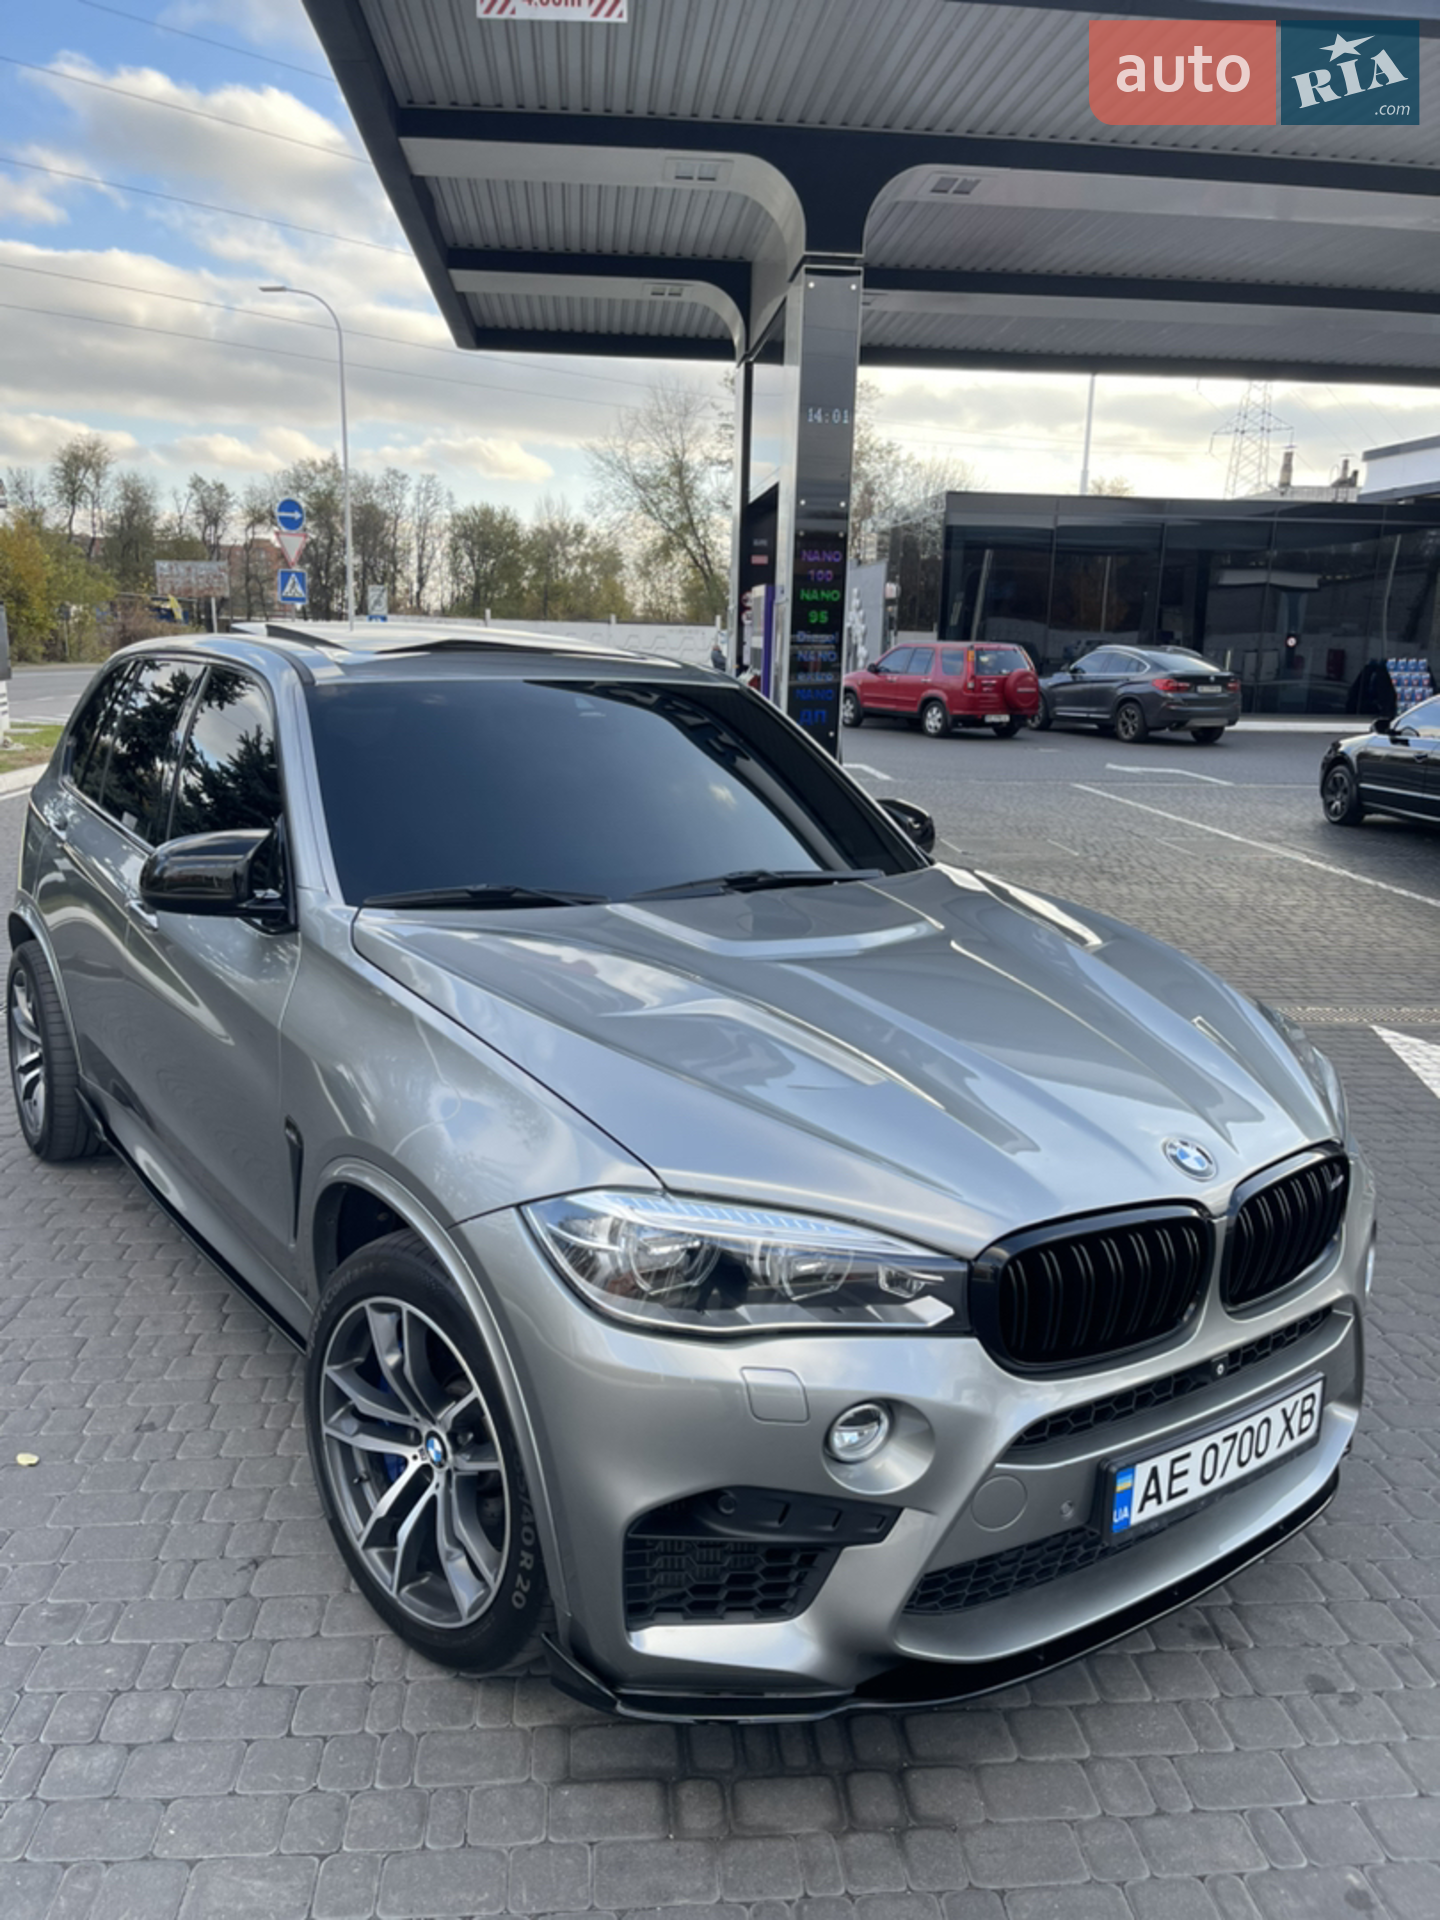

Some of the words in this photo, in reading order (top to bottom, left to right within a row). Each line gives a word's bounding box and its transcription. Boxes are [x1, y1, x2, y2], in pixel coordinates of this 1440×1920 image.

[807, 407, 849, 424] 14:01
[802, 550, 842, 562] NANO
[809, 570, 833, 582] 100
[800, 589, 840, 601] NANO
[808, 610, 828, 624] 95
[797, 650, 837, 662] NANO
[795, 689, 833, 701] NANO
[1137, 1451, 1192, 1514] AE
[1200, 1416, 1272, 1486] 0700
[1276, 1392, 1317, 1449] XB
[1112, 1505, 1130, 1523] UA
[519, 1550, 534, 1571] R
[511, 1574, 531, 1609] 20
